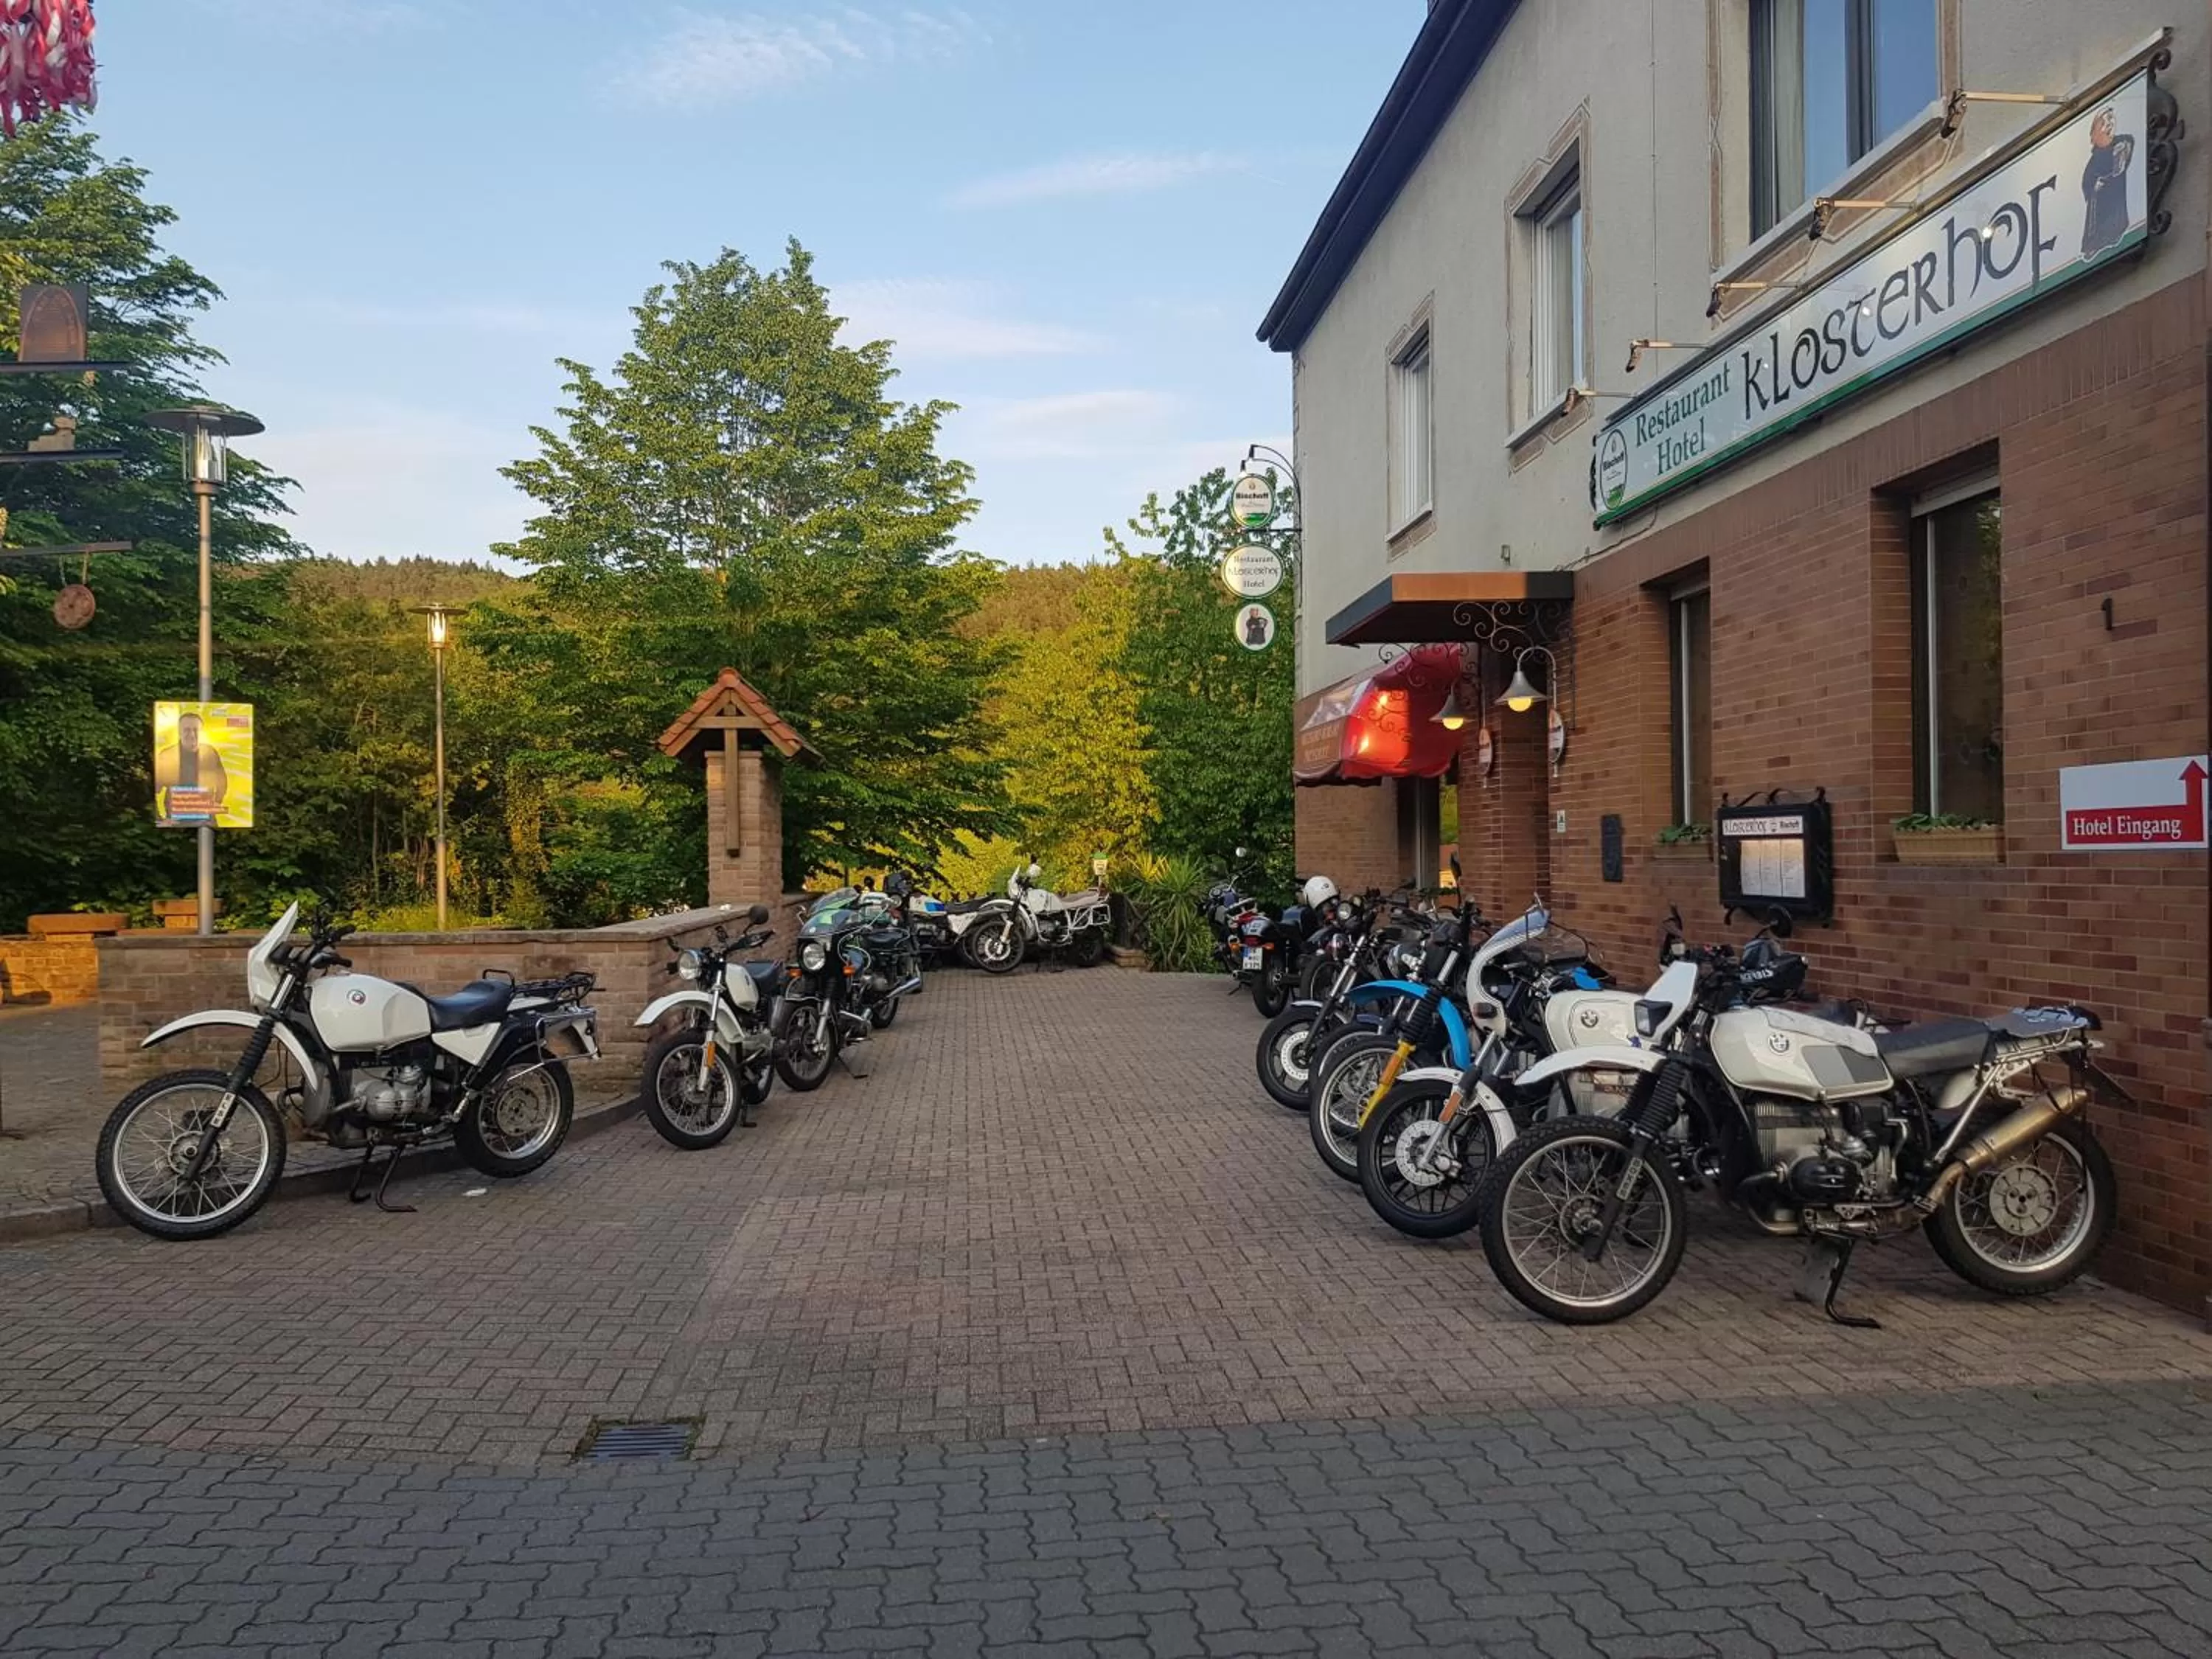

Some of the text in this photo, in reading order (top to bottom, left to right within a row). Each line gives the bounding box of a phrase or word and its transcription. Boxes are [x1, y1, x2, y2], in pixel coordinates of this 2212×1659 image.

[1635, 361, 1730, 448] Restaurant
[1657, 416, 1706, 476] Hotel
[2073, 815, 2183, 841] Hotel Eingang
